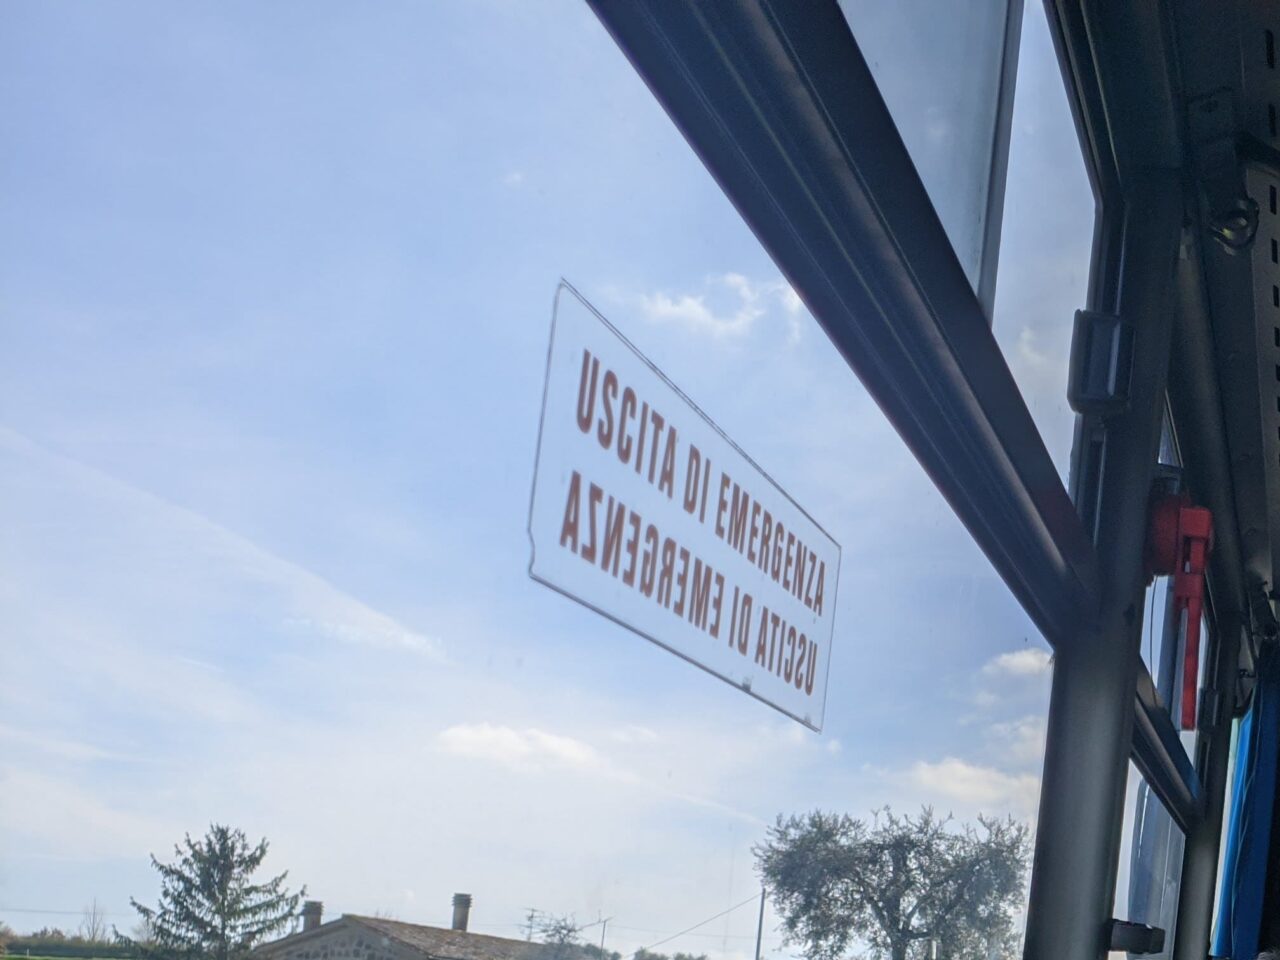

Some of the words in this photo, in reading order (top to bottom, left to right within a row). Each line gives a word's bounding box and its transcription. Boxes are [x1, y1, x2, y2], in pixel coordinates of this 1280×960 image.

[576, 347, 677, 500] USCITA
[683, 443, 711, 524] DI
[715, 471, 826, 618] EMERGENZA
